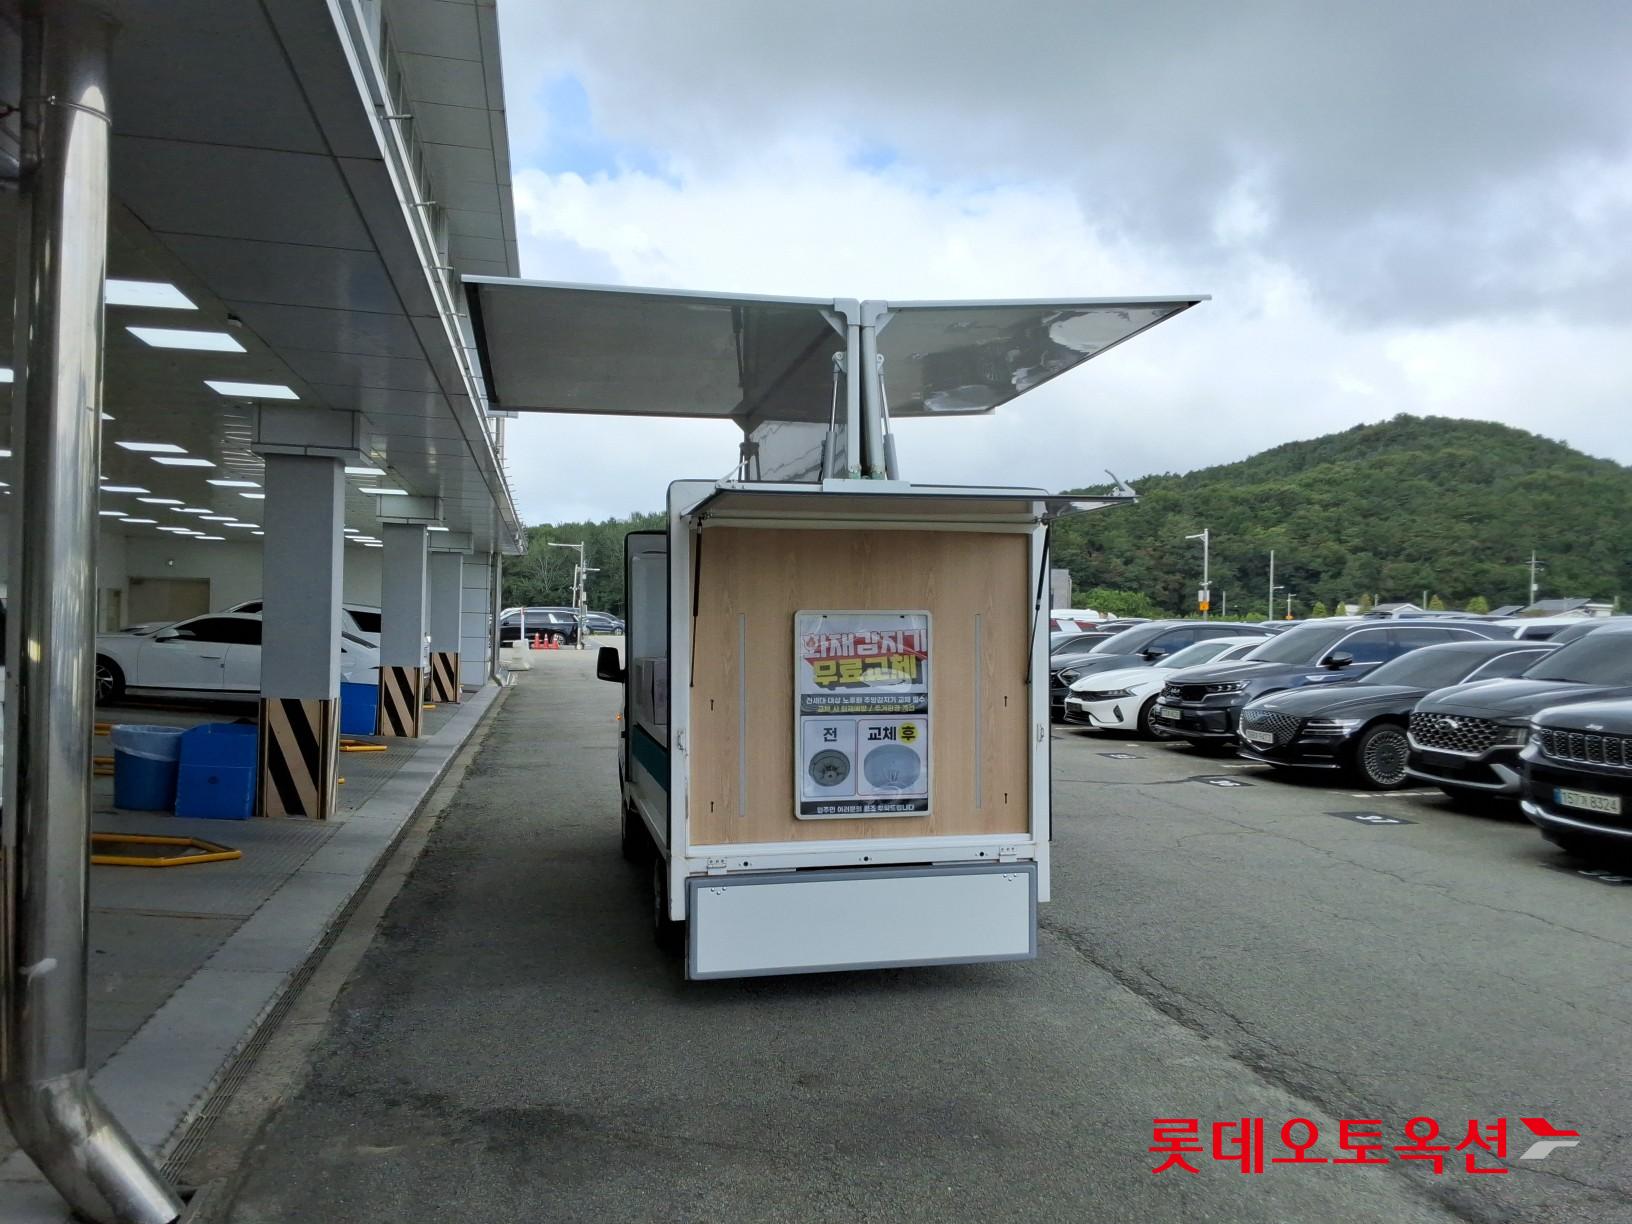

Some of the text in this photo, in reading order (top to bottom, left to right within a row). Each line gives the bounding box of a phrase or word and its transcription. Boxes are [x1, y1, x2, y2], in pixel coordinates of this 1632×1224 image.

[800, 630, 927, 657] 화재감지기
[815, 655, 917, 686] 무료교체
[823, 727, 838, 742] 전
[868, 726, 916, 741] 교체 후
